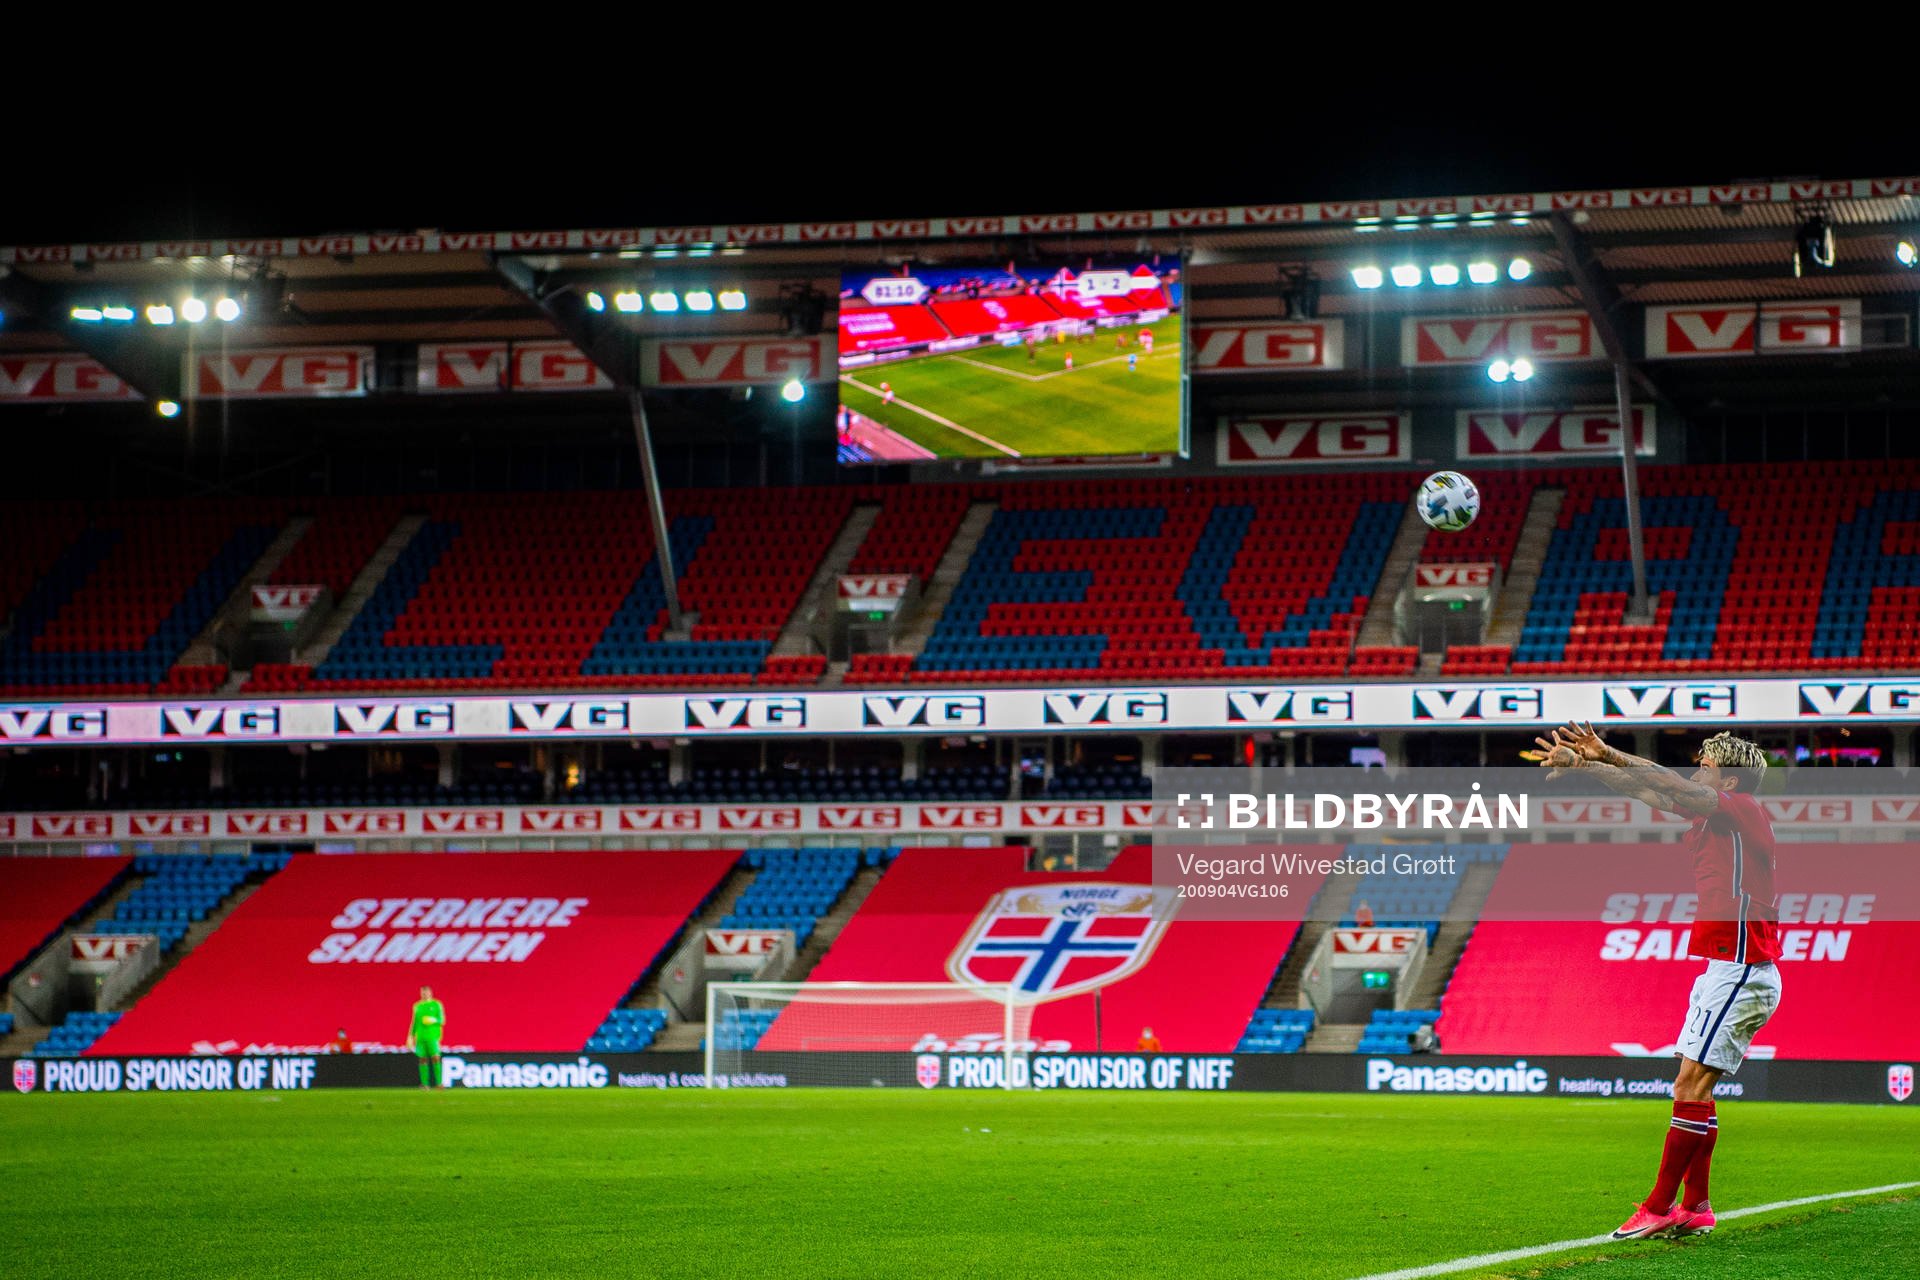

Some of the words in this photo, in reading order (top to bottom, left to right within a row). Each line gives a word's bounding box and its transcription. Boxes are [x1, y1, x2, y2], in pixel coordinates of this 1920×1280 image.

[18, 246, 69, 261] VG
[90, 244, 139, 259] VG
[303, 239, 352, 254] VG
[372, 236, 422, 251] VG
[444, 234, 493, 249] VG
[514, 233, 565, 248] VG
[586, 230, 637, 245] VG
[658, 228, 709, 244] VG
[730, 226, 782, 242] VG
[802, 224, 853, 240] VG
[876, 222, 927, 238] VG
[950, 219, 1002, 234] VG
[1023, 216, 1075, 232] VG
[1098, 214, 1150, 230] VG
[1173, 210, 1225, 226] VG
[1248, 206, 1300, 223] VG
[1555, 194, 1610, 208] VG
[1634, 190, 1689, 206] VG
[1712, 187, 1768, 203] VG
[1793, 183, 1850, 198] VG
[1423, 318, 1582, 359] VG
[1669, 312, 1834, 350] VG
[205, 354, 351, 394] VG
[441, 350, 598, 388] VG
[663, 343, 814, 379] VG
[0, 361, 122, 397] VG
[1236, 420, 1391, 456] VG
[1475, 414, 1636, 450] VG
[840, 577, 905, 598] VG
[1419, 566, 1491, 586] VG
[0, 709, 106, 738] VG
[164, 707, 279, 736] VG
[338, 704, 451, 734] VG
[513, 702, 628, 732] VG
[687, 699, 804, 729] VG
[866, 696, 983, 727] VG
[1046, 694, 1166, 724] VG
[1231, 692, 1353, 721] VG
[1415, 689, 1541, 719] VG
[1605, 686, 1735, 717] VG
[1802, 684, 1920, 715] VG
[37, 818, 109, 836] VG
[134, 816, 207, 836] VG
[232, 815, 304, 834] VG
[328, 813, 402, 832] VG
[427, 812, 500, 831] VG
[526, 811, 599, 830] VG
[624, 810, 697, 829] VG
[723, 809, 799, 829] VG
[823, 808, 898, 828] VG
[924, 807, 1000, 827] VG
[1025, 806, 1101, 826] VG
[1547, 802, 1629, 822] VG
[1764, 801, 1850, 822] VG
[1875, 801, 1920, 821] V
[1060, 889, 1118, 899] NORGE
[1601, 893, 1876, 925] STEERE
[331, 897, 588, 929] STERKERE
[308, 932, 545, 964] SAMMEN
[1336, 932, 1415, 953] VG
[1600, 929, 1851, 962] SAEN
[1688, 1006, 1712, 1038] 21
[44, 1060, 121, 1092] PROUD
[125, 1059, 234, 1091] SPONSOR
[237, 1059, 267, 1090] OF
[272, 1058, 315, 1089] NFF
[443, 1057, 608, 1088] Panasonic
[618, 1072, 667, 1089] heating
[1033, 1057, 1145, 1088] SPONSOR
[1152, 1058, 1182, 1089] OF
[1188, 1059, 1233, 1090] NFF
[1366, 1059, 1548, 1092] Panasonic
[1559, 1077, 1611, 1096] heating
[1615, 1078, 1625, 1093] &
